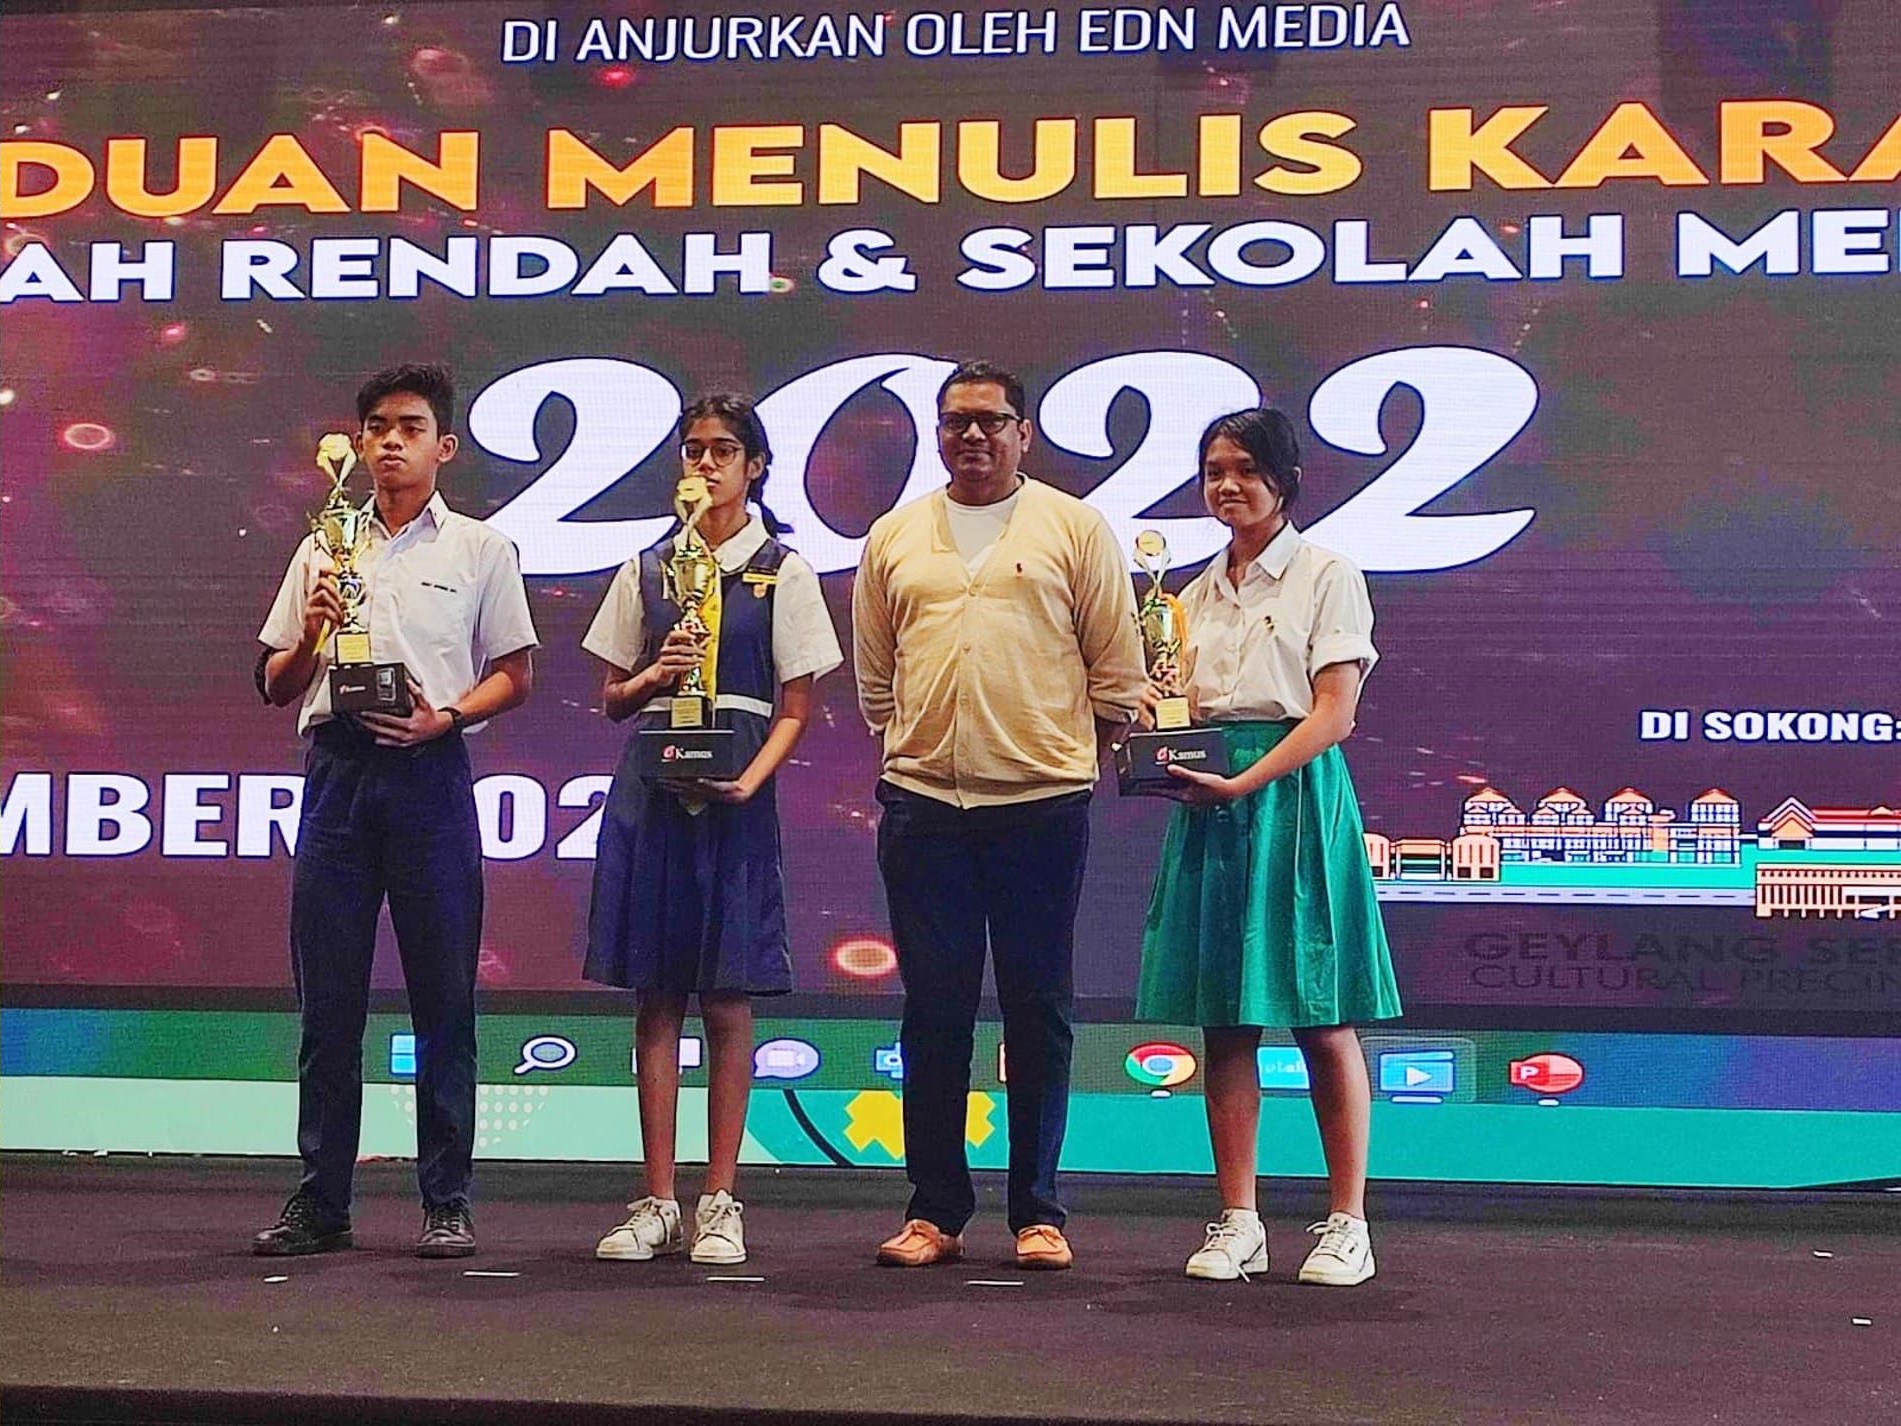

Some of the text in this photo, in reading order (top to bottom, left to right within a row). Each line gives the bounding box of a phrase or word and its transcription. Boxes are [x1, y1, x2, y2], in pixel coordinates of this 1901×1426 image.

[502, 3, 1410, 62] DI ANJURKAN OLEH EDN MEDIA
[547, 110, 1363, 209] MENULIS
[221, 233, 771, 300] RENDAH
[818, 230, 916, 293] &
[957, 214, 1623, 290] SEKOLAH
[1679, 209, 1901, 276] ME
[468, 347, 1537, 574] 2022
[1640, 710, 1689, 740] DI
[1463, 931, 1778, 963] GEYLANG
[1470, 964, 1726, 991] CULTURAL
